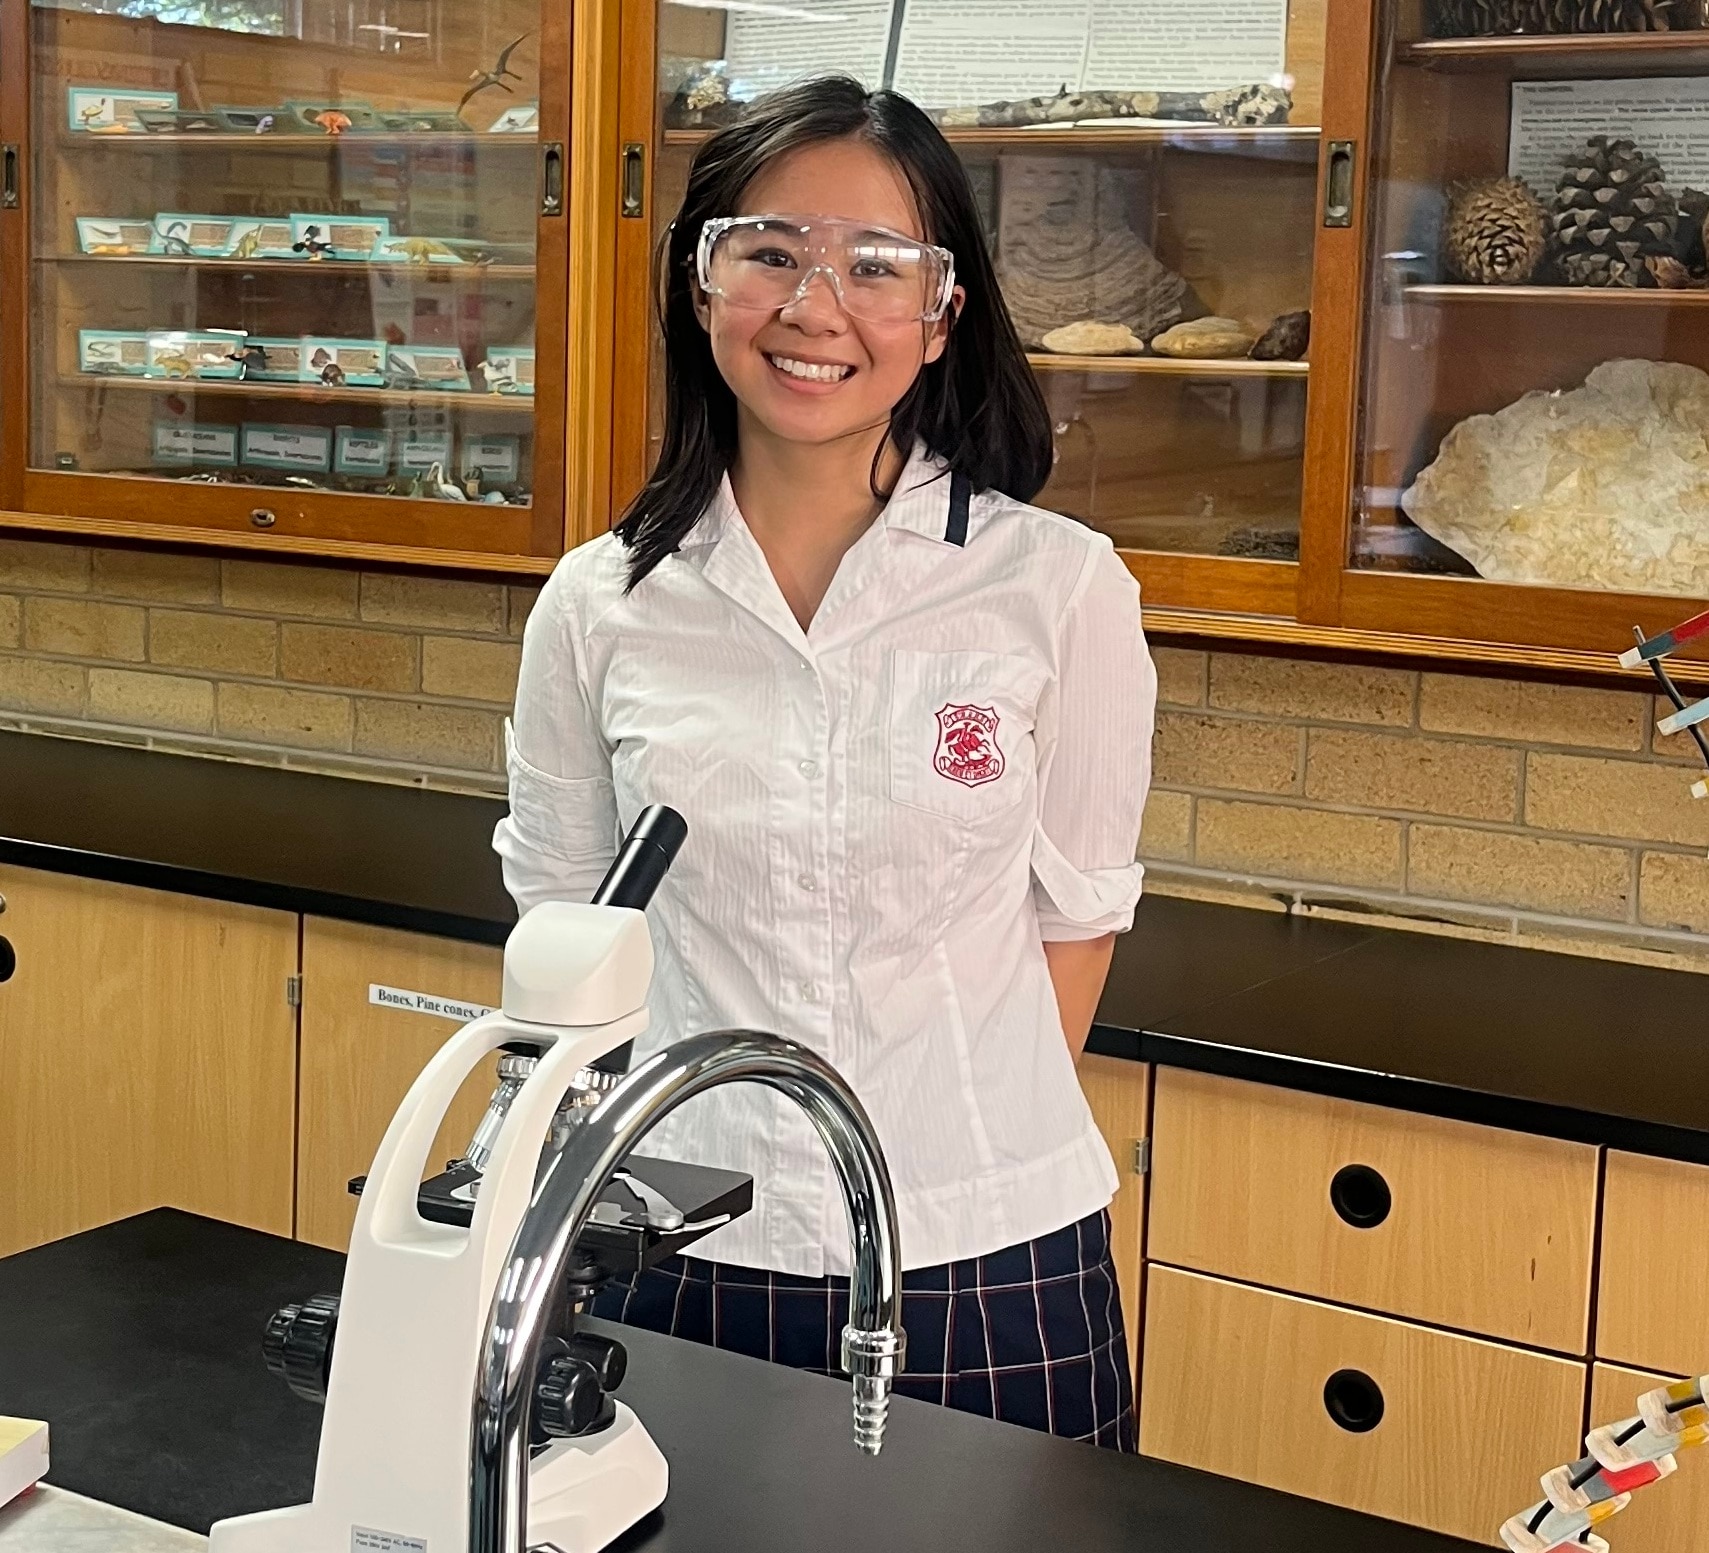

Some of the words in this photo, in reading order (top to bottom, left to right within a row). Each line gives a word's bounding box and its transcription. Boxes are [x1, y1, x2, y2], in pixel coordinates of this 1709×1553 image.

[378, 988, 413, 1007] Bones,
[417, 995, 440, 1012] Pine
[443, 1003, 477, 1018] cones,
